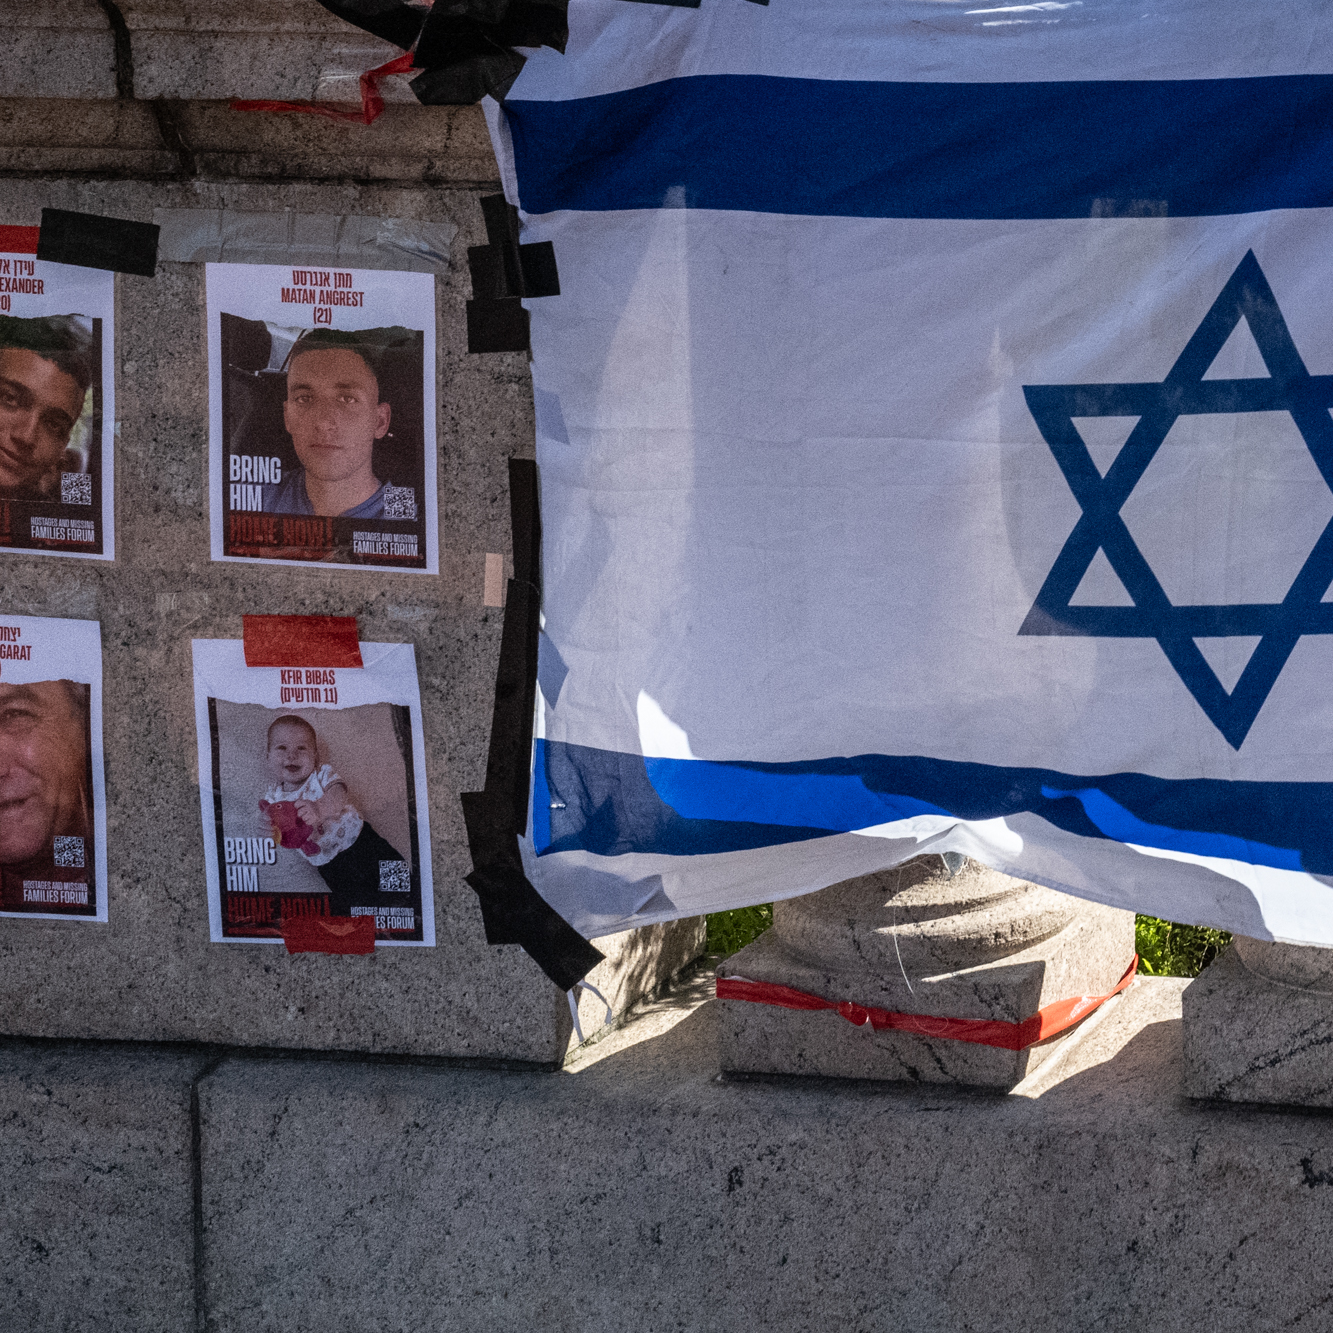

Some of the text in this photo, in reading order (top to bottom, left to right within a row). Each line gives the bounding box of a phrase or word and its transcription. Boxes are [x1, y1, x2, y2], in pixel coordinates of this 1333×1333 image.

[333, 272, 352, 290] מתן
[281, 287, 365, 307] MATAN ANGREST
[313, 306, 332, 325] (21)
[229, 454, 282, 484] BRING
[229, 484, 264, 512] HIM
[31, 526, 95, 543] FAMILIES FORUM
[353, 531, 381, 542] HOSTAGES
[382, 532, 393, 542] AND
[353, 541, 418, 556] FAMILIES FORUM
[280, 669, 336, 685] KFIR BIBAS
[224, 837, 276, 864] BRING
[226, 866, 260, 892] HIM
[23, 889, 89, 905] FAMILIES FORUM
[227, 895, 275, 923] HOME
[350, 907, 414, 916] HOSTAGES AND MISSING
[387, 916, 415, 930] FORUM
